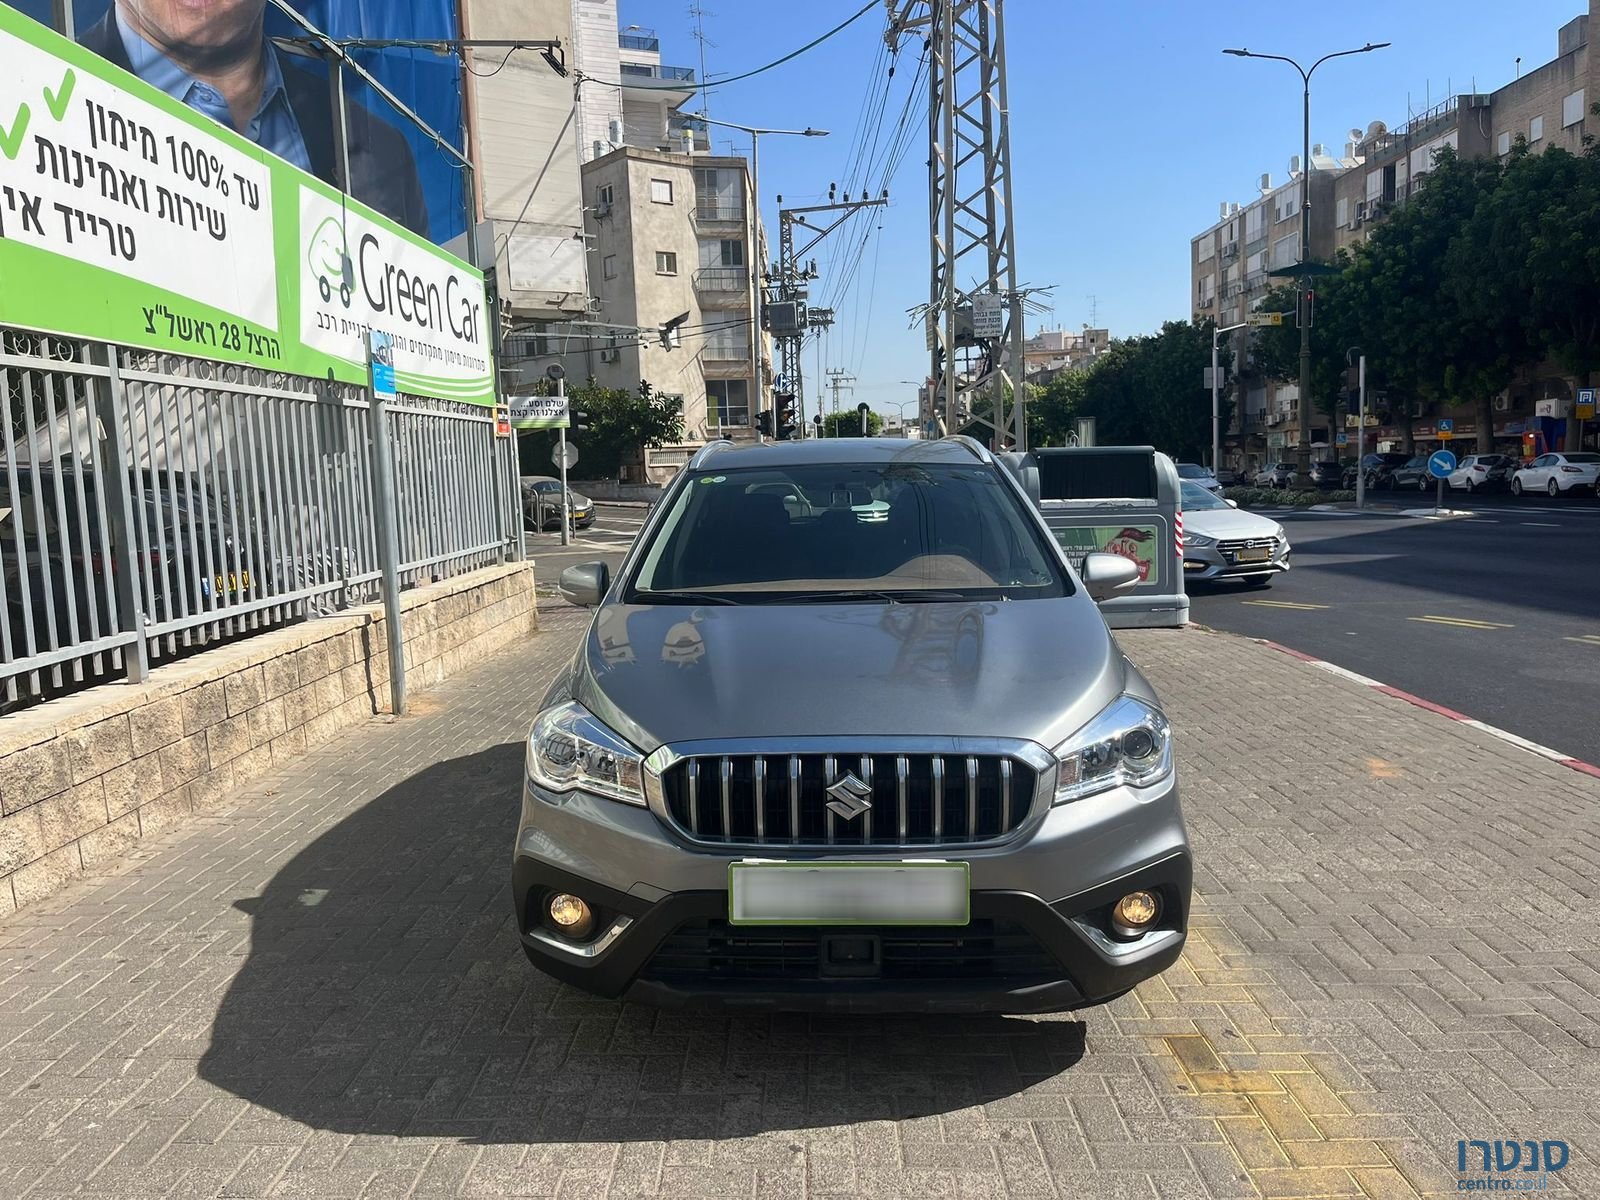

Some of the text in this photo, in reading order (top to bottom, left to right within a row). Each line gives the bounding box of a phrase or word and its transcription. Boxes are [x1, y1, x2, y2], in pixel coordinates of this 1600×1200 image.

[85, 98, 260, 211] עד 100% מימון
[34, 135, 226, 241] שירות ואמינות
[54, 201, 136, 261] טרייד
[359, 233, 479, 345] Green Car
[142, 304, 281, 360] הרצל 28 ראשל"צ
[316, 311, 338, 333] רכב
[409, 339, 443, 363] מתקדמים
[510, 408, 565, 418] אצלנו זה קצת
[546, 399, 564, 408] שלם
